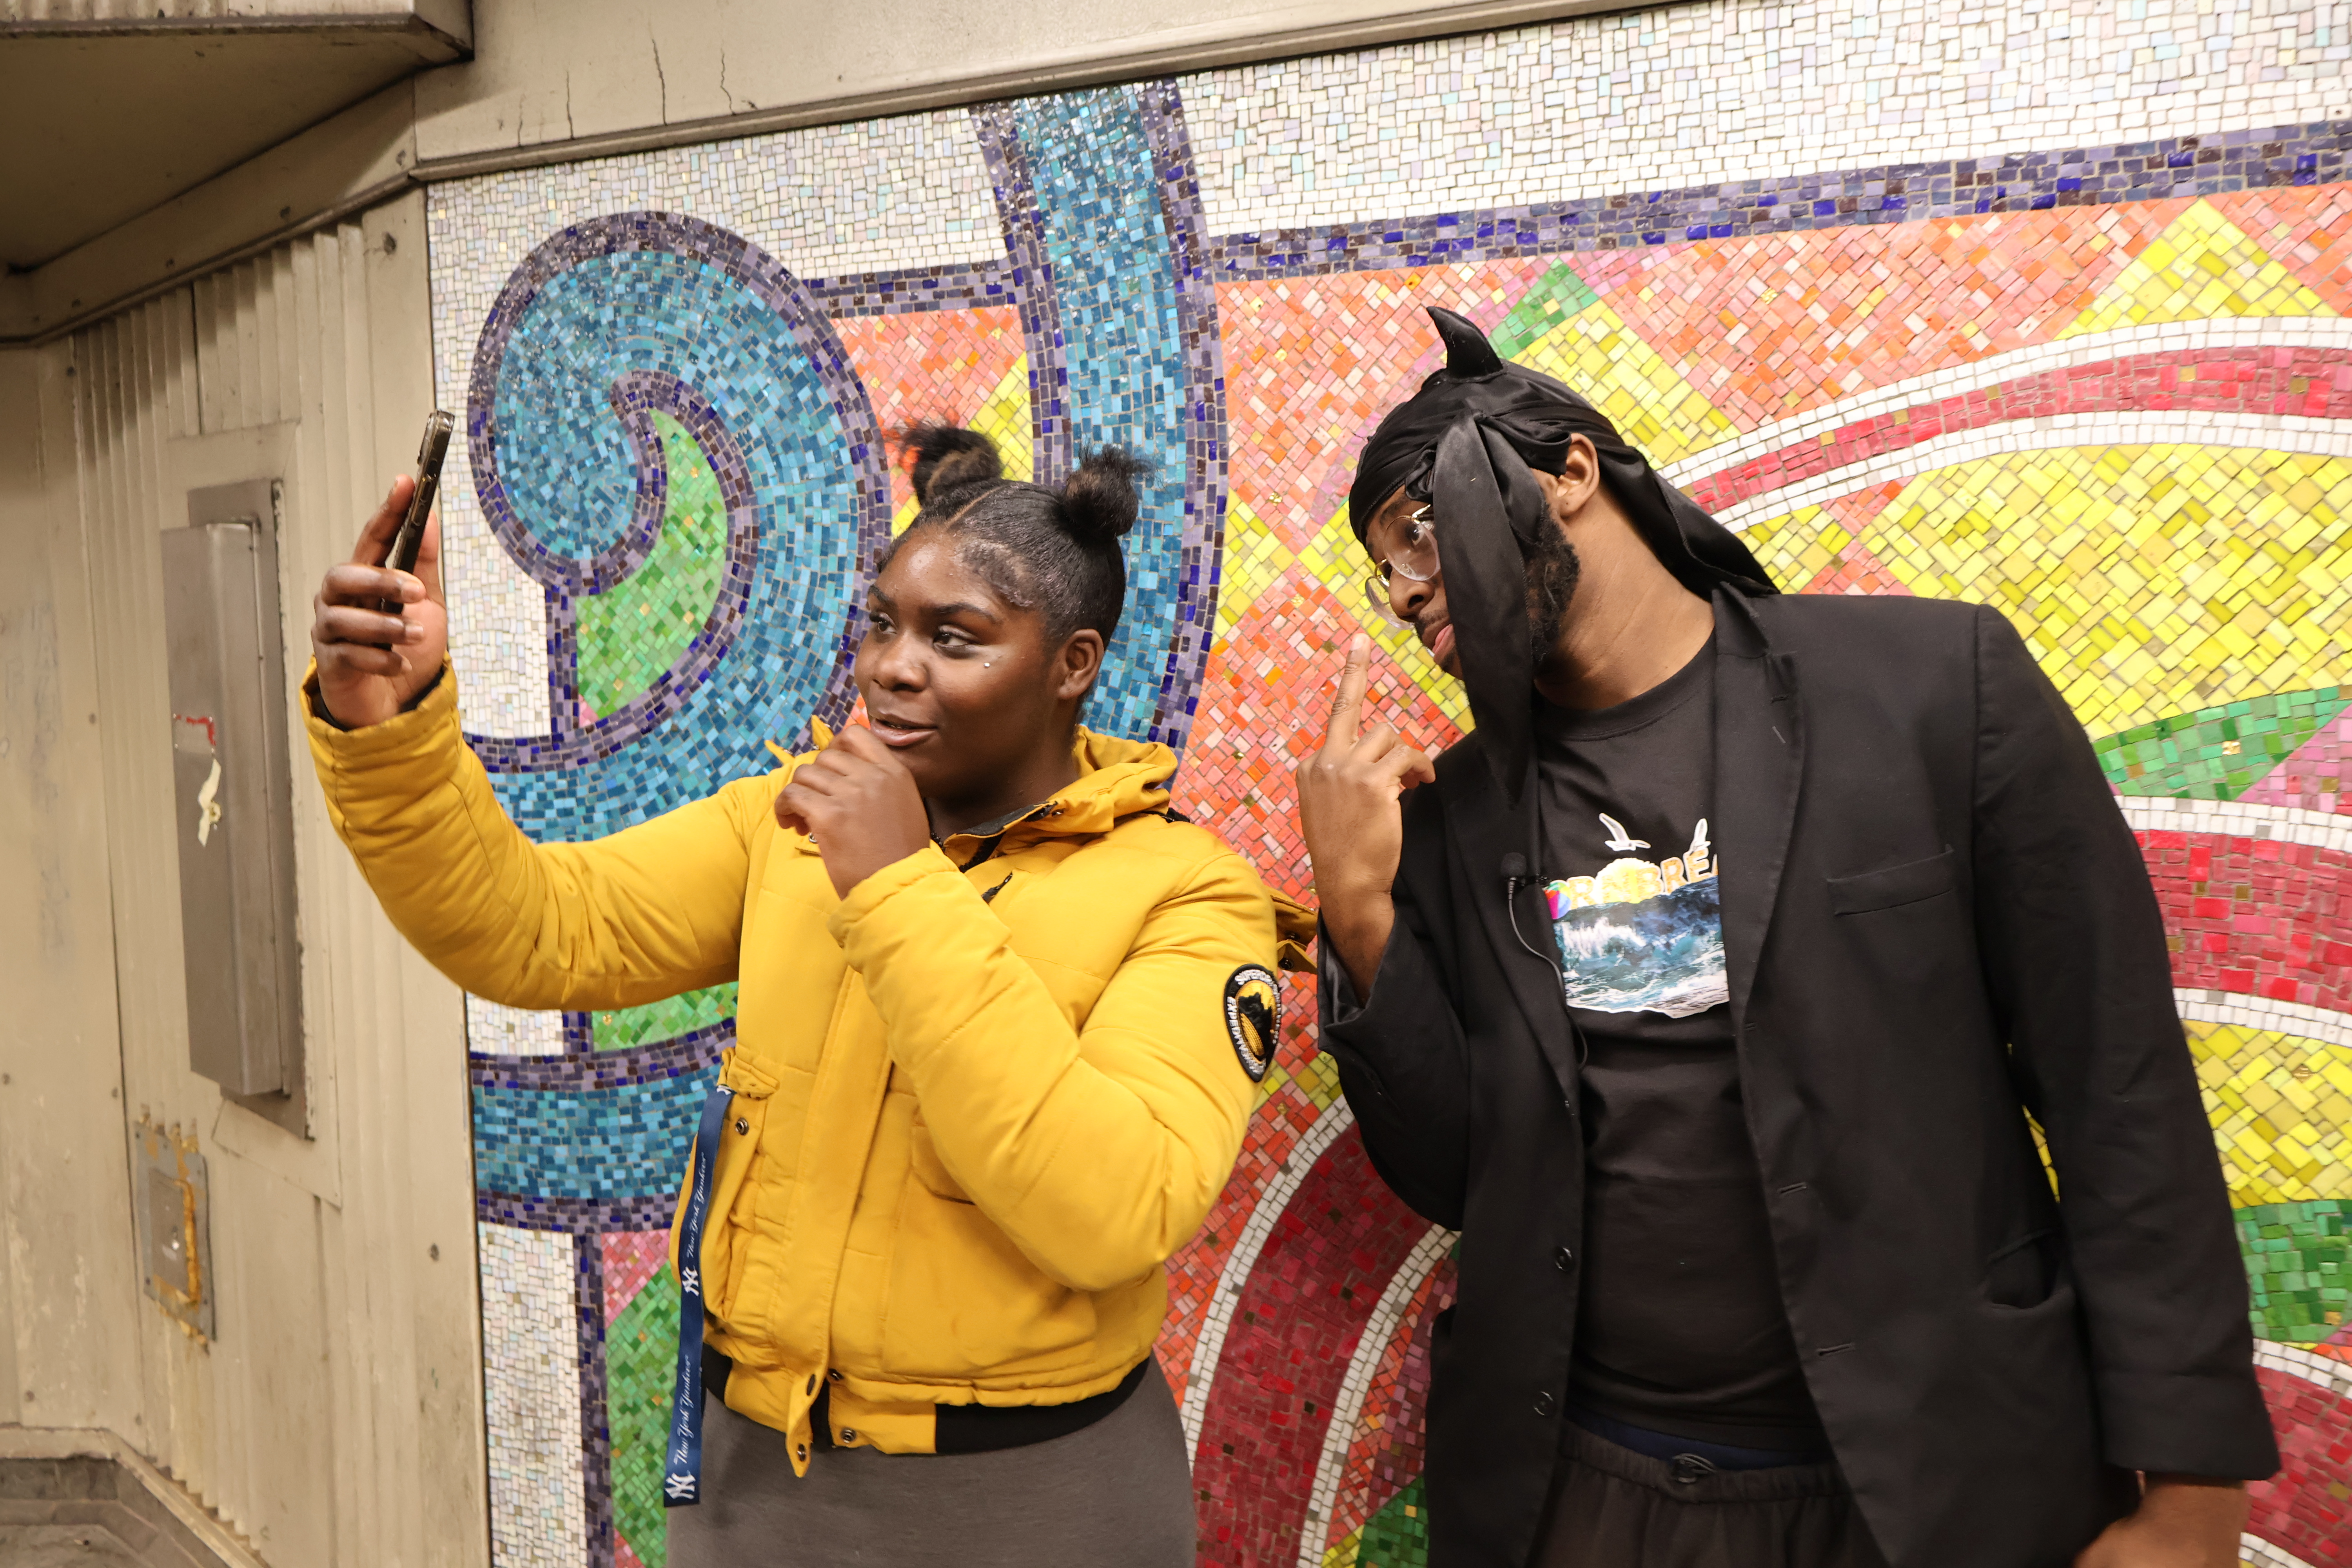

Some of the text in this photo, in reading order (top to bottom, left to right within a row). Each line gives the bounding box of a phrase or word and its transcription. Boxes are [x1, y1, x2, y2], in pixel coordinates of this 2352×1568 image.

[689, 1203, 699, 1234] York
[686, 1233, 695, 1258] New
[673, 1354, 694, 1465] New York Yankees
